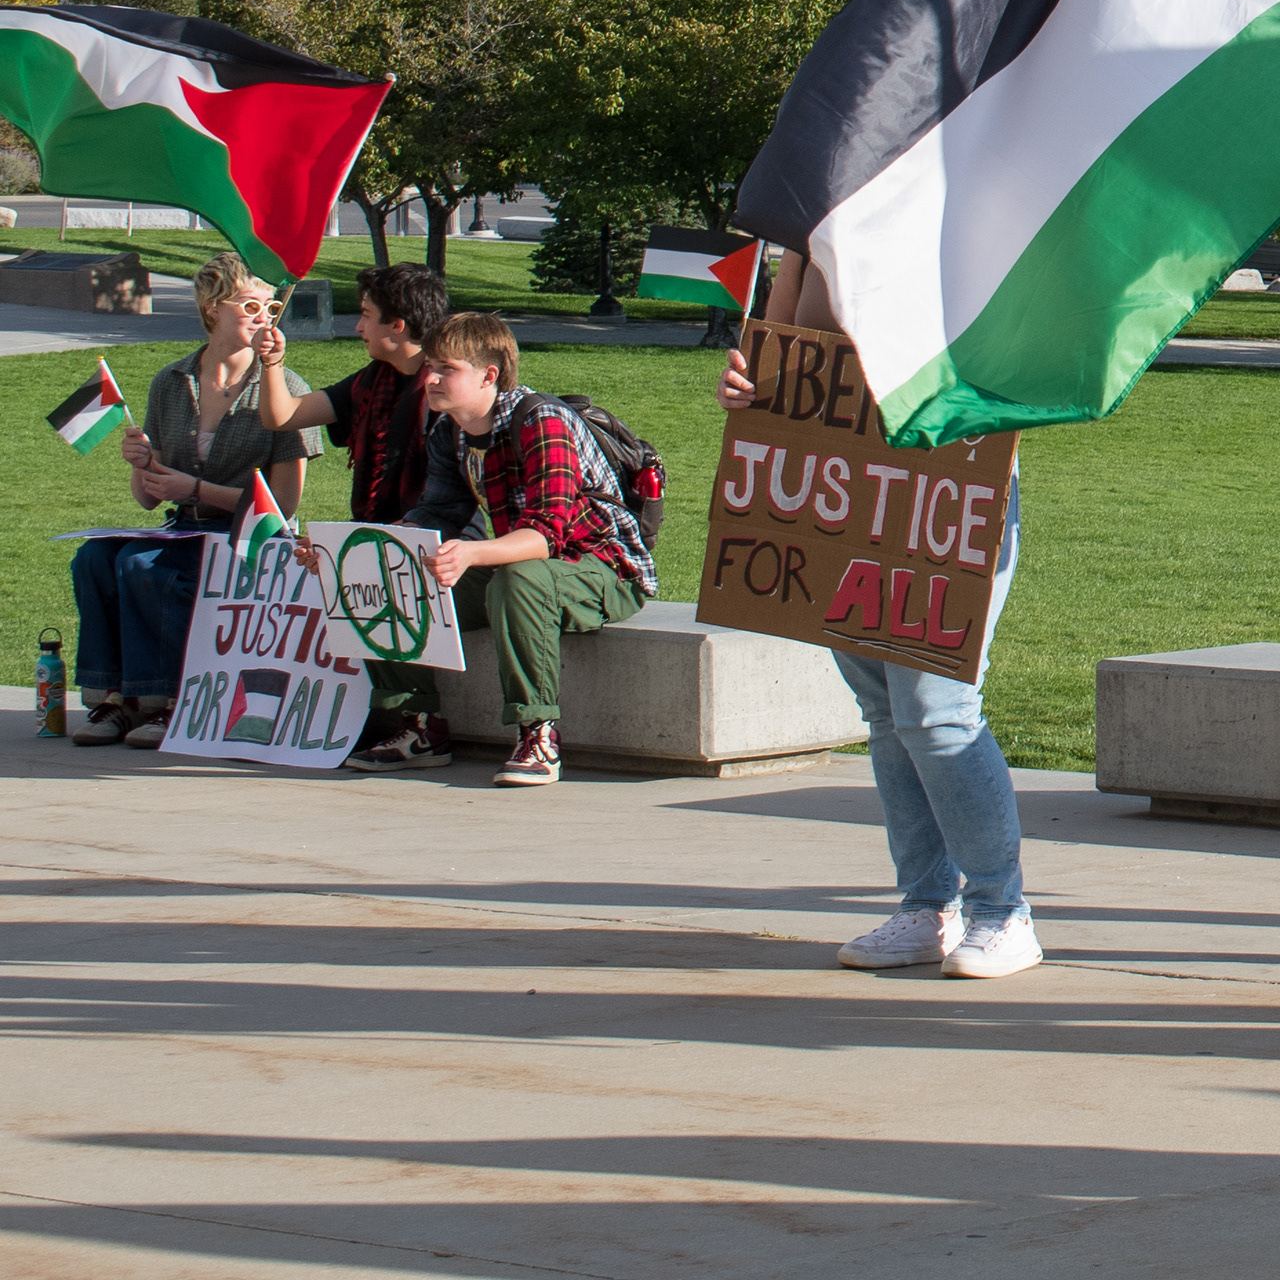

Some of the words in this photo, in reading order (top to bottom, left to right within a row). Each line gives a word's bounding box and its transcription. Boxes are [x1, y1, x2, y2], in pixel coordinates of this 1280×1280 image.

[723, 438, 997, 570] JUSTICE
[312, 543, 390, 617] Demand
[713, 536, 815, 604] FOR
[824, 558, 973, 650] ALL
[169, 671, 230, 742] FOR
[275, 675, 350, 751] ALL
